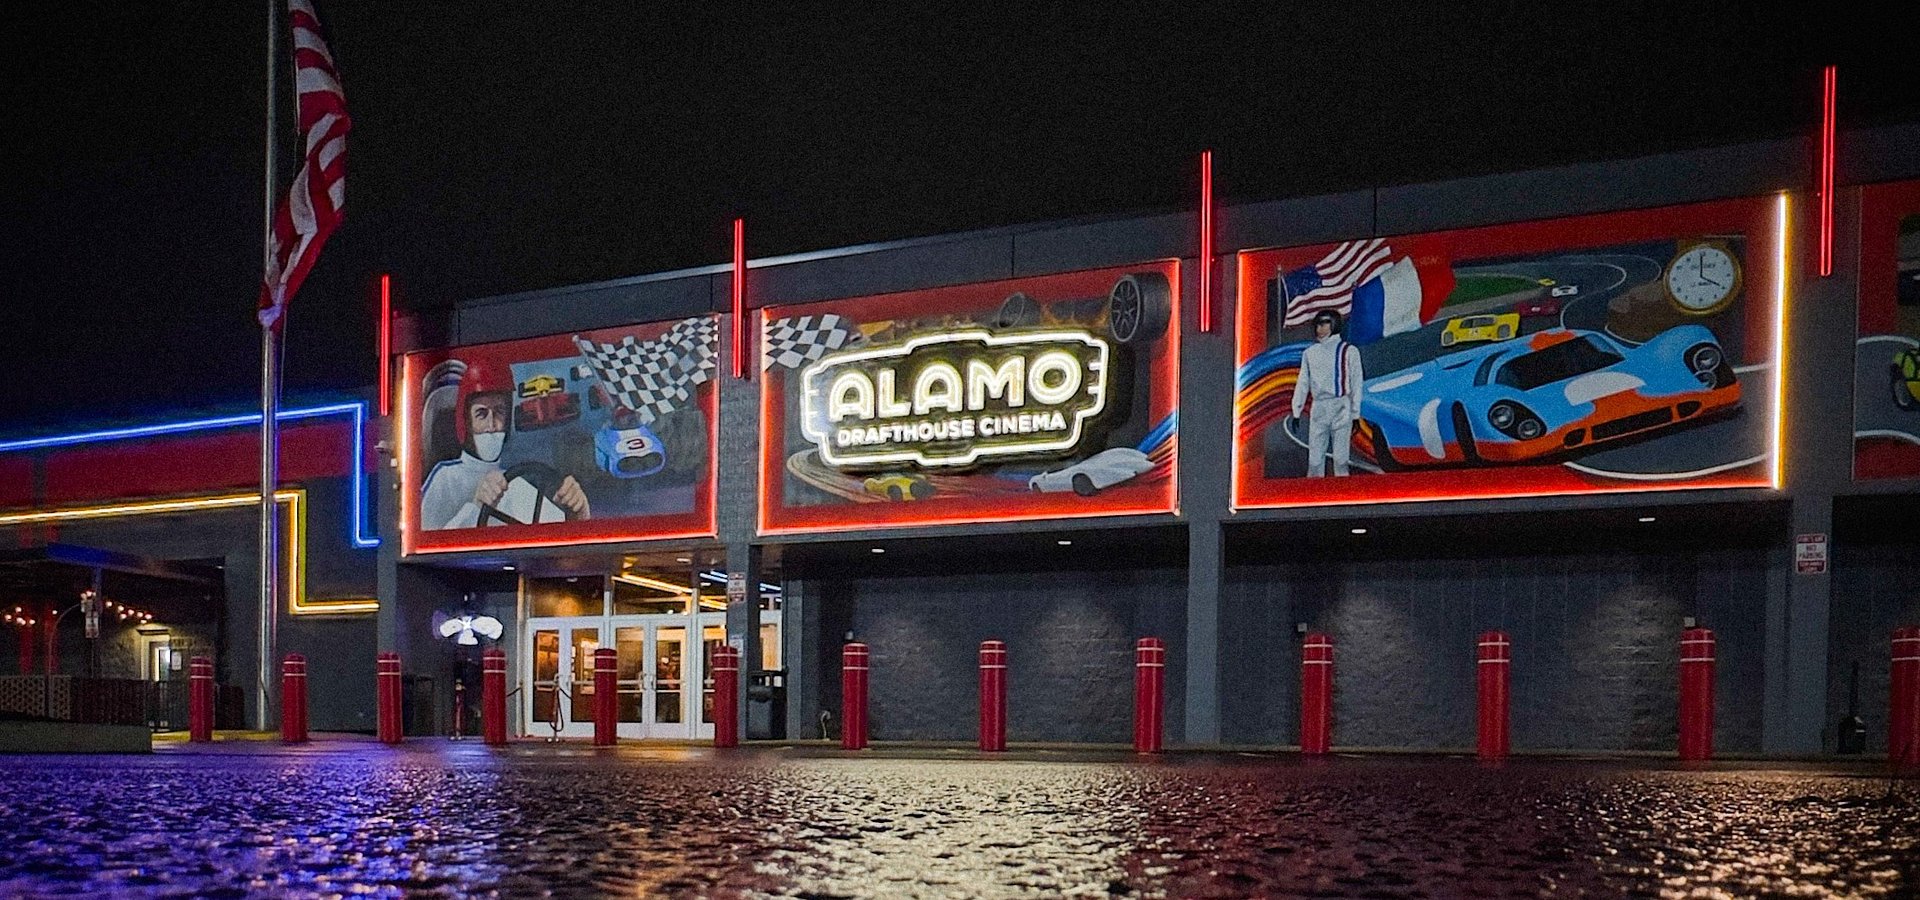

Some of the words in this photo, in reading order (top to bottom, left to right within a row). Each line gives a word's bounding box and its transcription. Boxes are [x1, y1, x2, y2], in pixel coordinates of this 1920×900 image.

[829, 352, 1082, 422] ALAMO
[626, 438, 645, 450] 3
[837, 419, 976, 447] DRAFTHOUSE
[979, 411, 1067, 437] CINEMA
